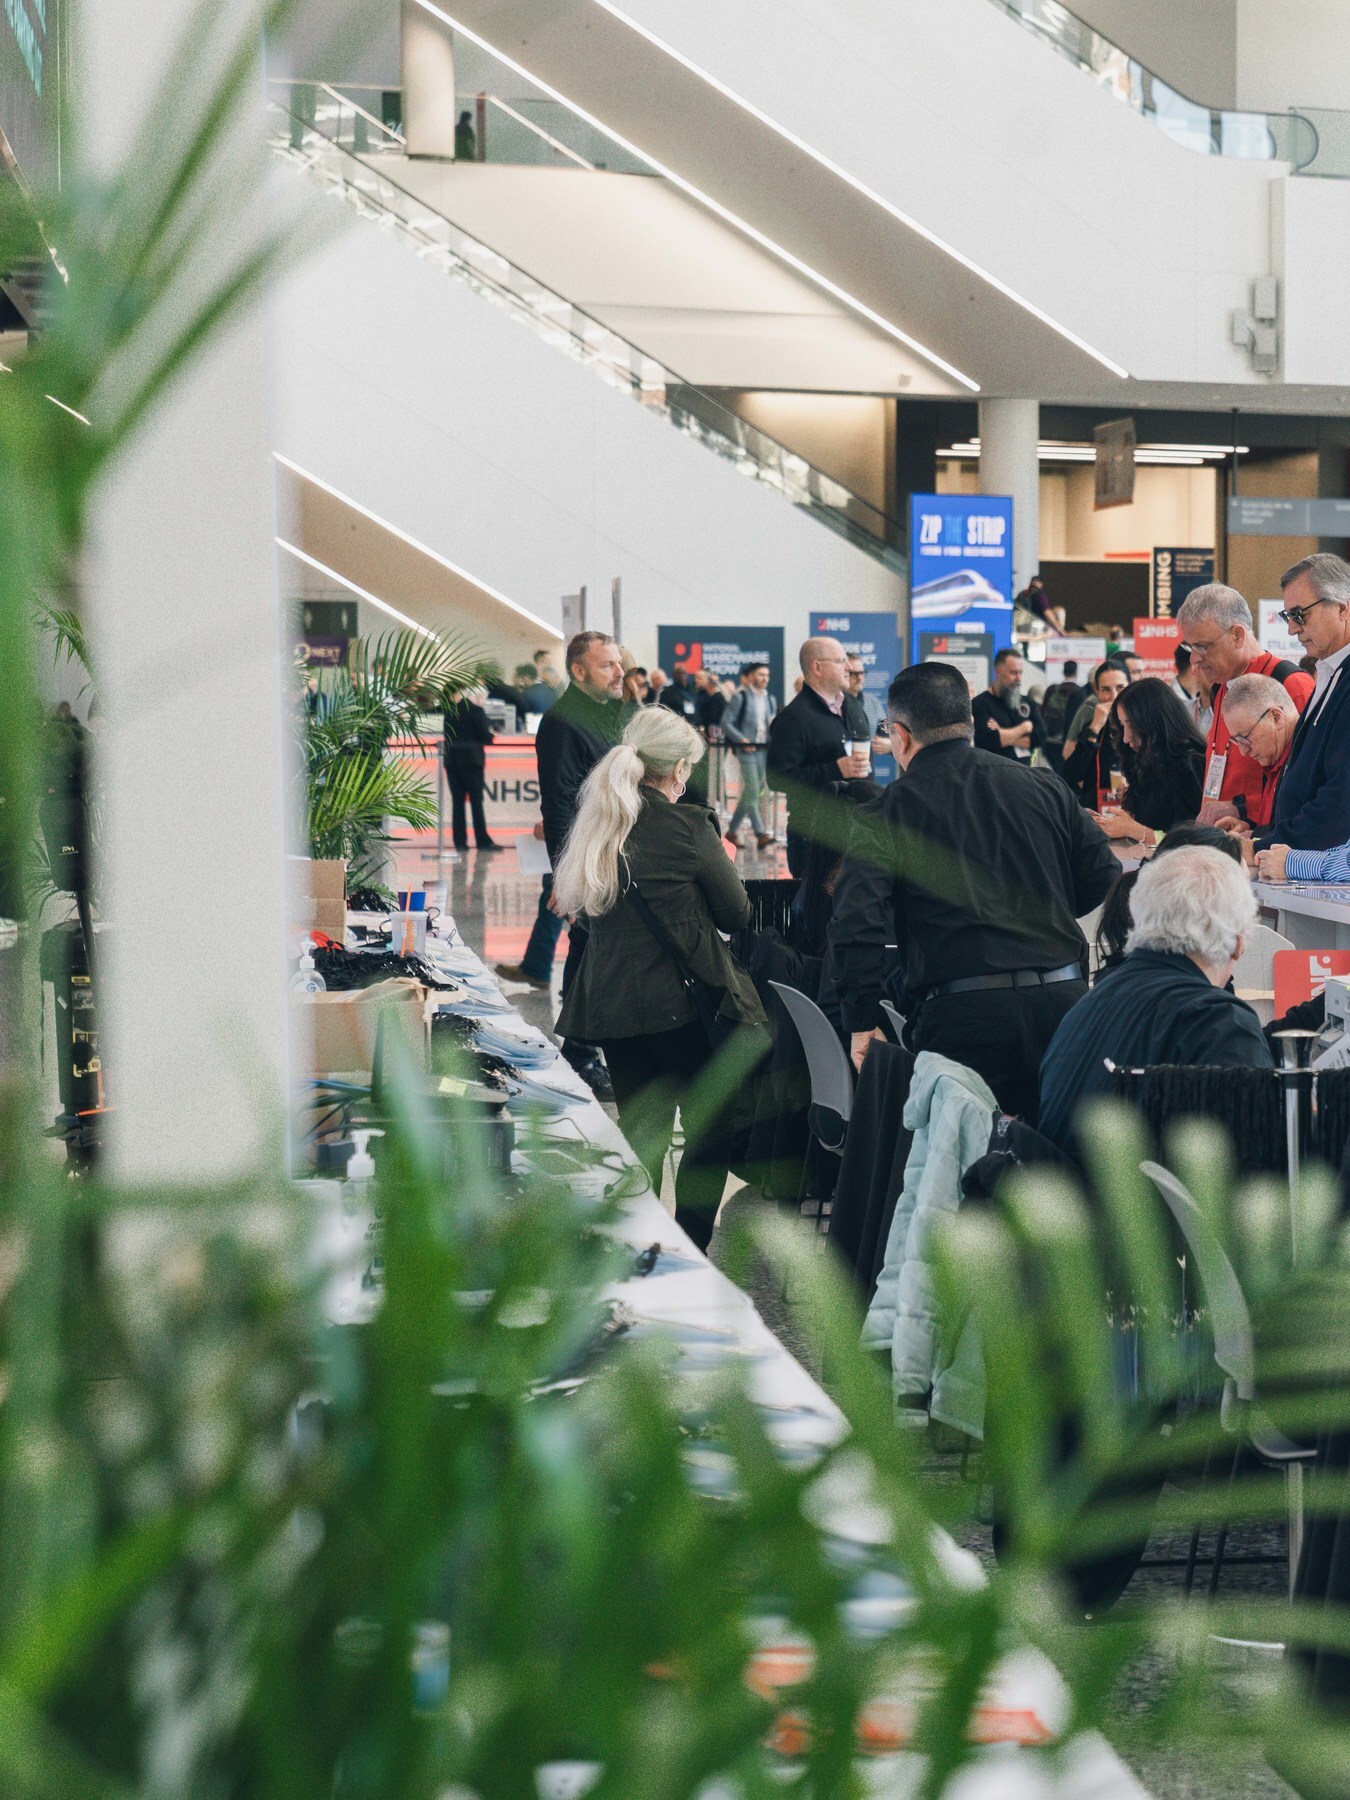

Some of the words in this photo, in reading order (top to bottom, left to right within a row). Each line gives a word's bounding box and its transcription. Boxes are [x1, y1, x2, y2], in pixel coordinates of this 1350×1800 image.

[920, 515, 942, 544] ZIP
[967, 515, 1005, 545] STRIP
[1157, 551, 1171, 619] MBING
[827, 618, 850, 631] NHS
[1149, 625, 1178, 638] NHS
[482, 780, 541, 803] NHS
